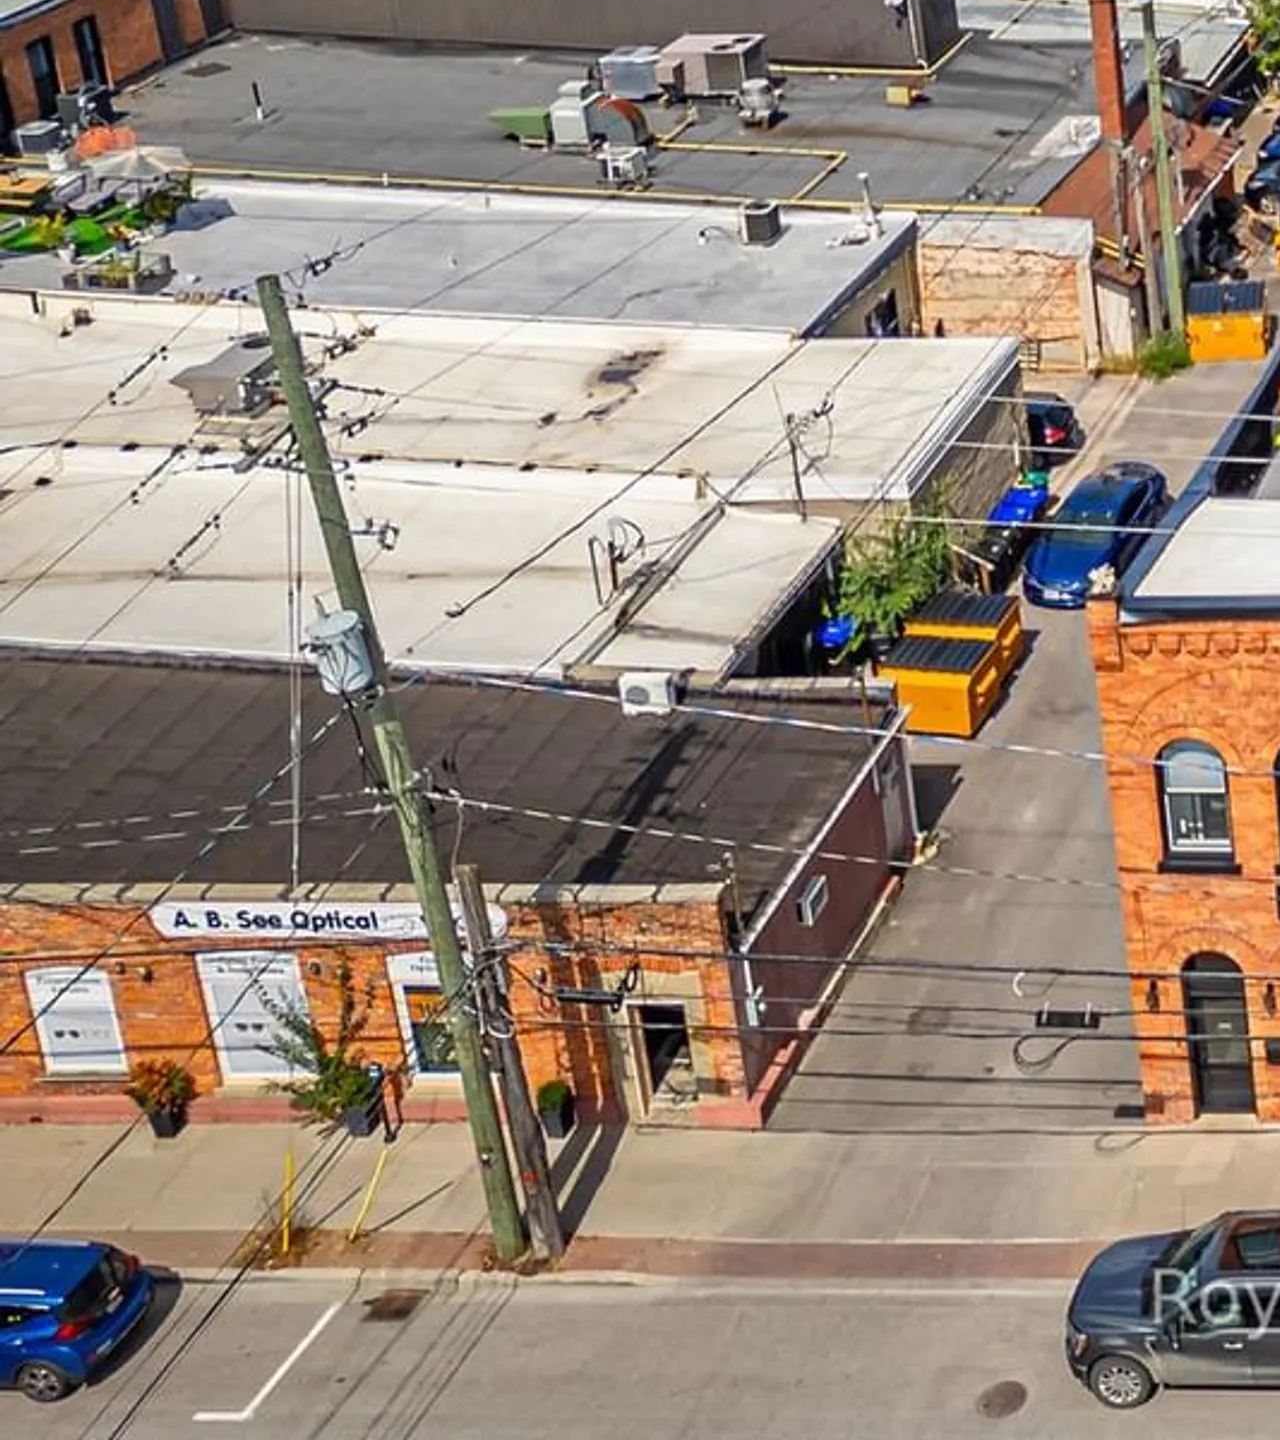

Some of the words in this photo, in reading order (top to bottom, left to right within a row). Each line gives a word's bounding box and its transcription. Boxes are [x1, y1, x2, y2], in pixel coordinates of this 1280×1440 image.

[174, 911, 198, 928] A.
[205, 910, 230, 928] B.
[236, 910, 283, 929] See
[290, 910, 380, 933] Optical
